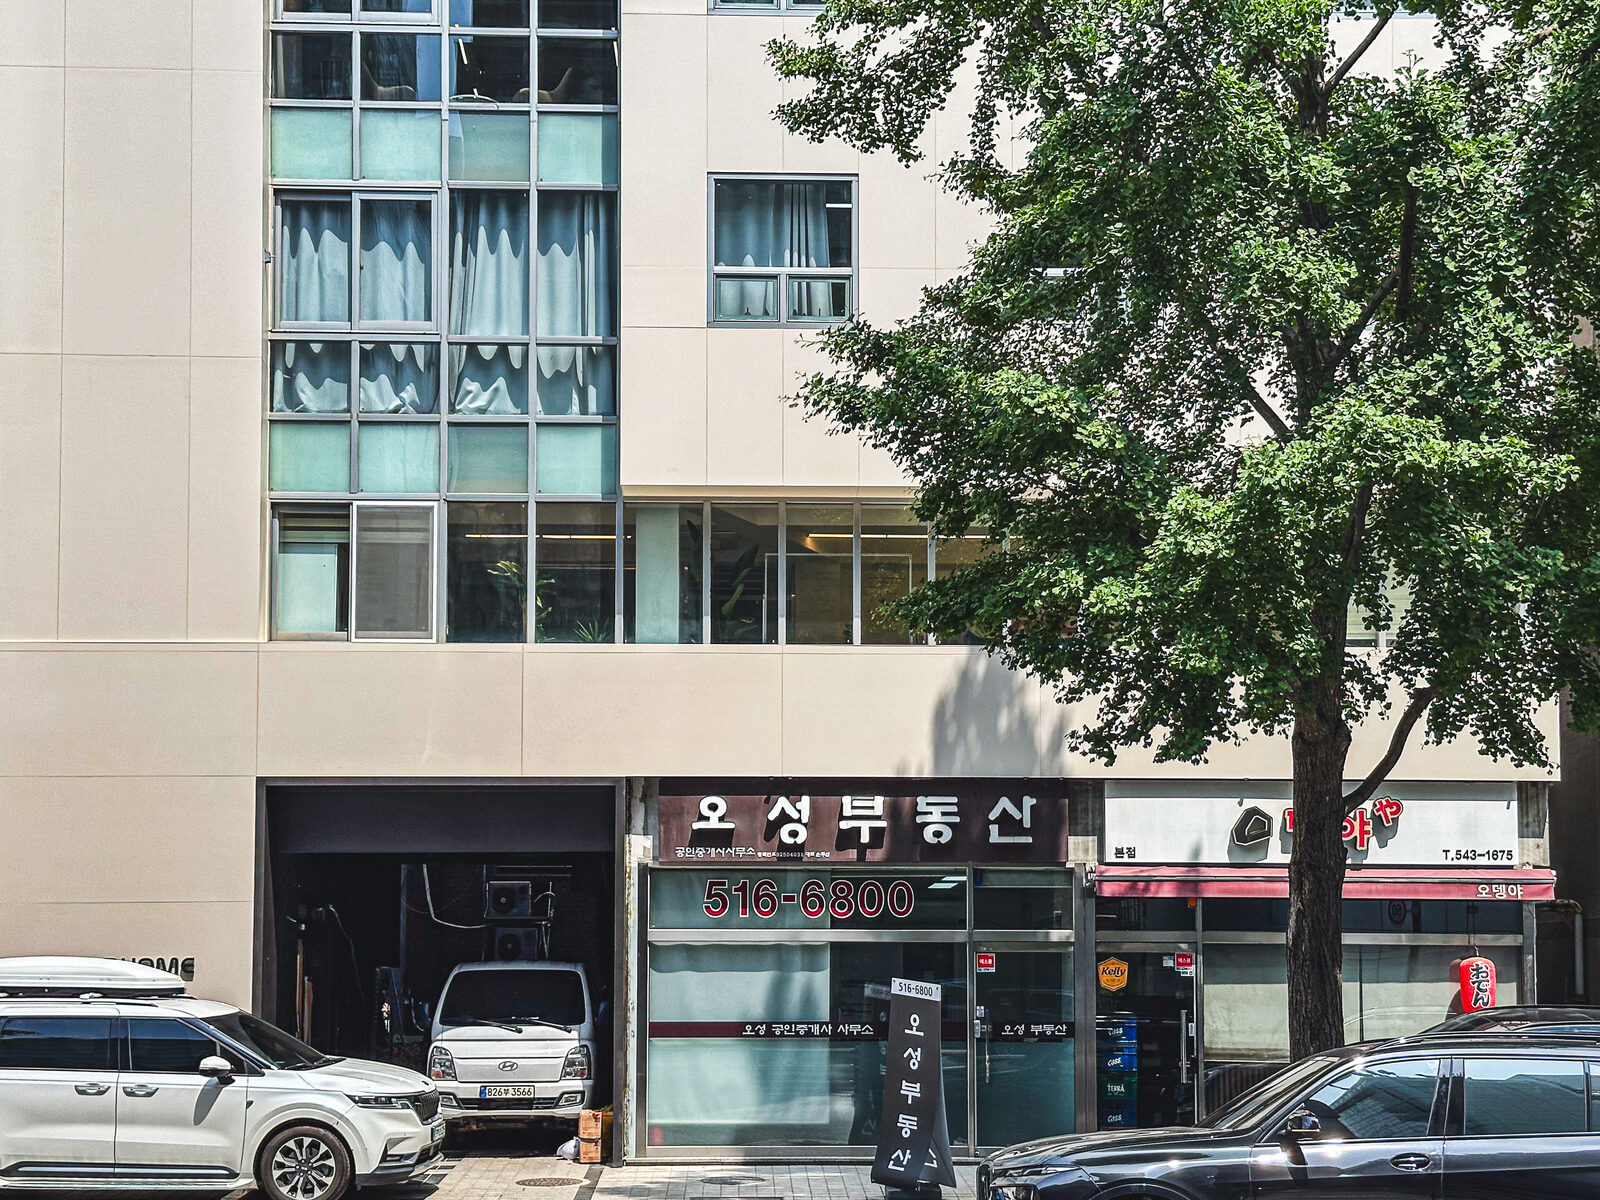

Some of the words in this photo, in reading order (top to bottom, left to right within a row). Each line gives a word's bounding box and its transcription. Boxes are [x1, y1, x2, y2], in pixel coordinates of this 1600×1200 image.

[691, 795, 1037, 845] 오성부동산
[1114, 846, 1136, 859] 본점
[1476, 884, 1524, 899] 오뎅야
[703, 879, 915, 919] 516-6800
[1101, 966, 1126, 977] Kelly
[898, 982, 933, 997] 516-6800
[1469, 962, 1491, 1008] おでん
[742, 1024, 766, 1035] 오성
[772, 1024, 832, 1035] 공인중개사
[837, 1024, 874, 1035] 사무소
[1001, 1024, 1025, 1035] 오성
[1030, 1024, 1067, 1035] 부동산
[511, 1087, 532, 1096] 3566
[888, 1013, 924, 1171] 오성부동산
[1107, 1084, 1125, 1093] TERRA
